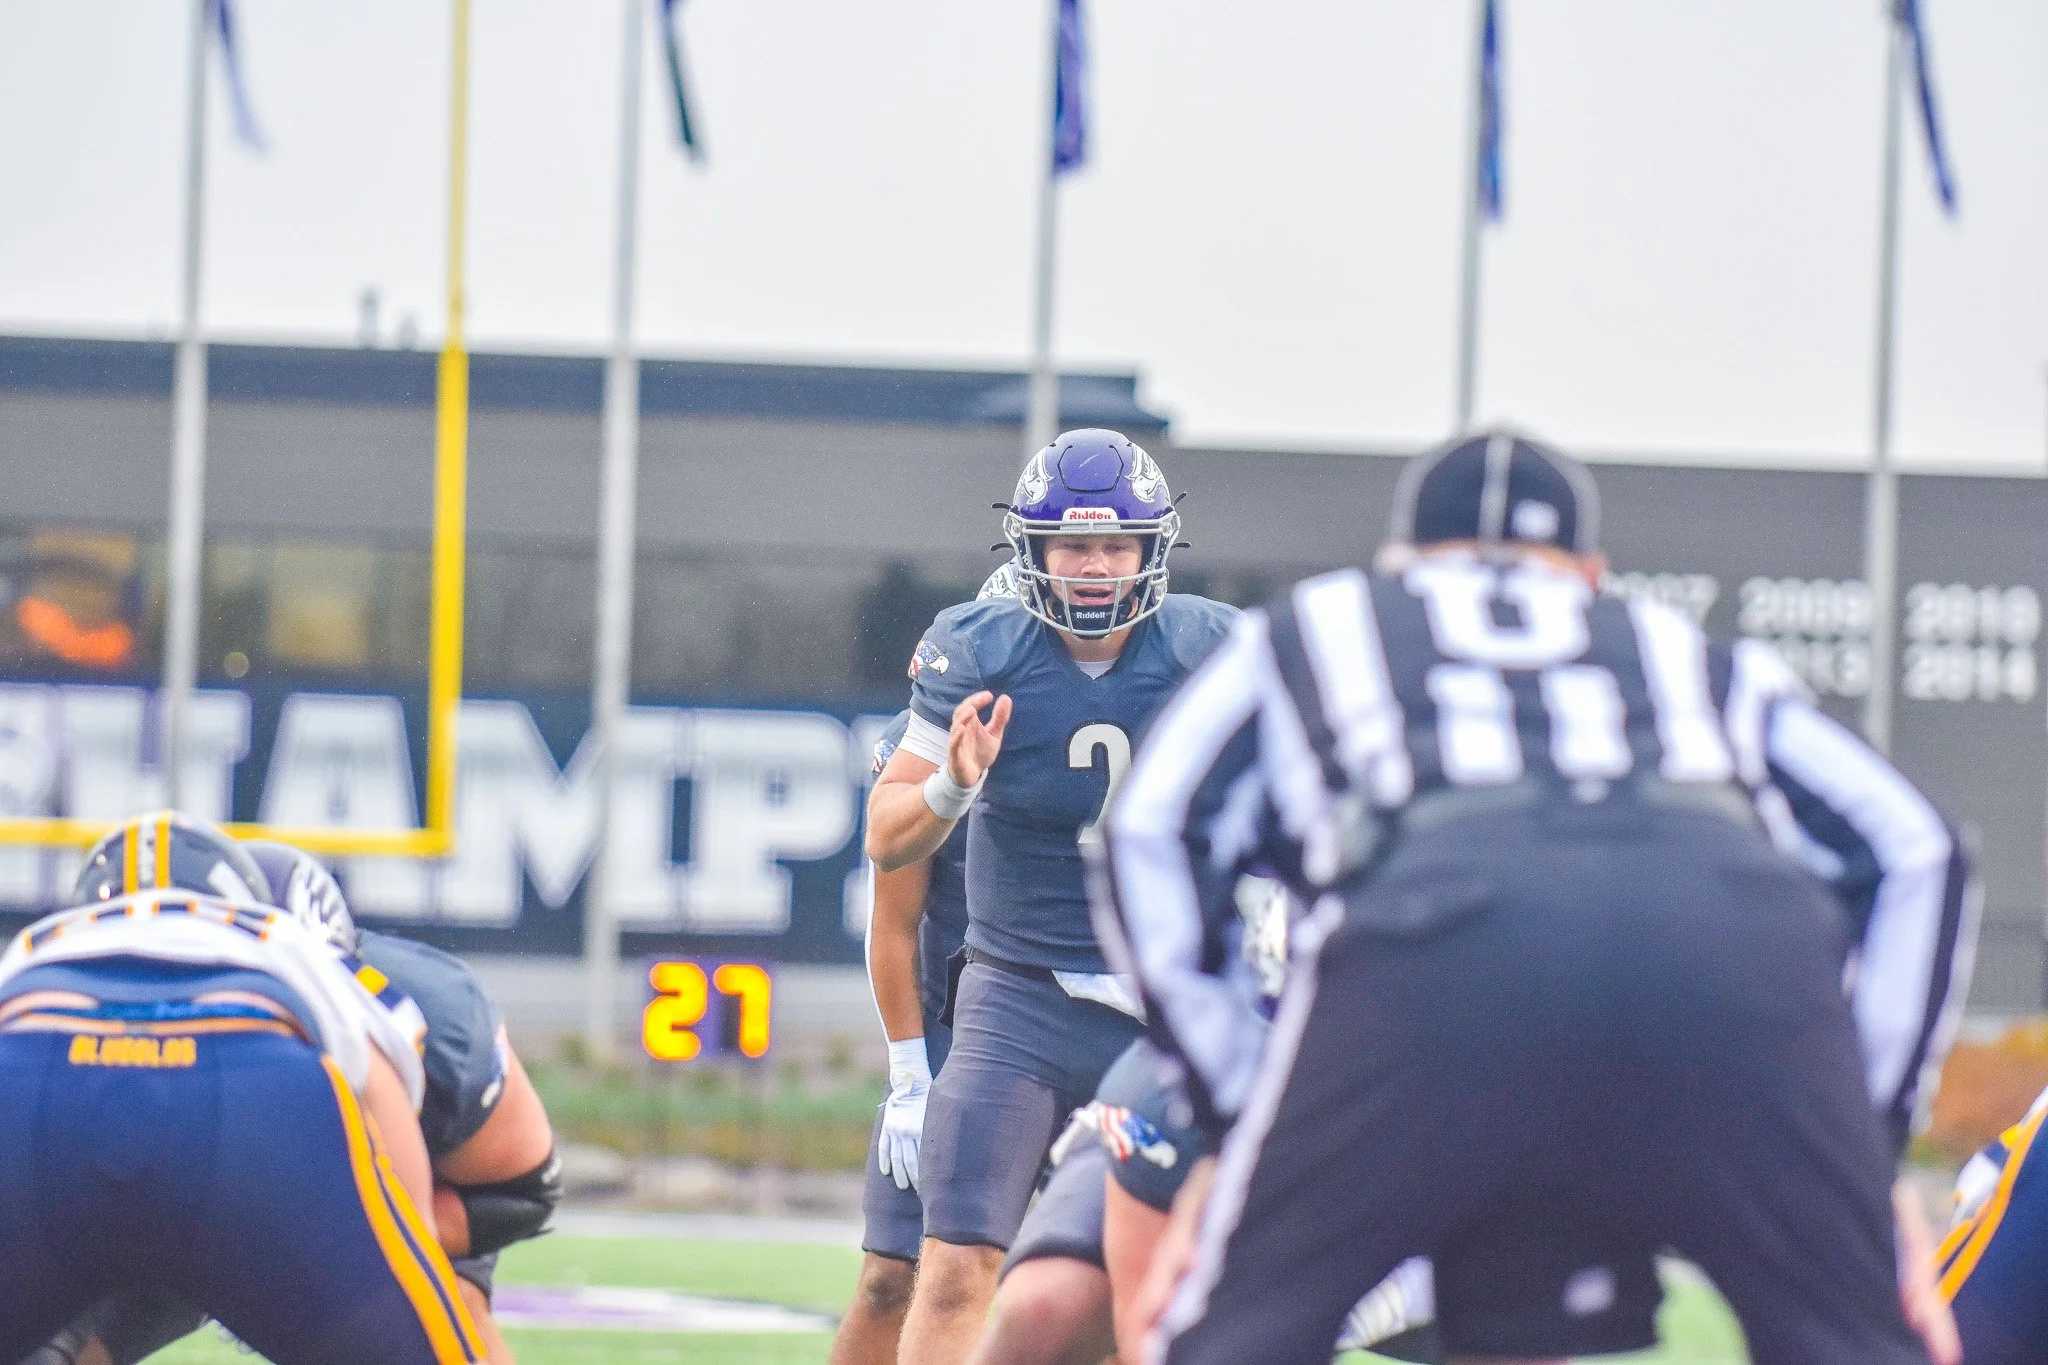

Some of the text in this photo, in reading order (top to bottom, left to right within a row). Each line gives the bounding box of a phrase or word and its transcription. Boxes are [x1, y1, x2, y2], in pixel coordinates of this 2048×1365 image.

[1076, 611, 1106, 620] Riddell
[1068, 723, 1133, 845] 2
[643, 962, 772, 1062] 27
